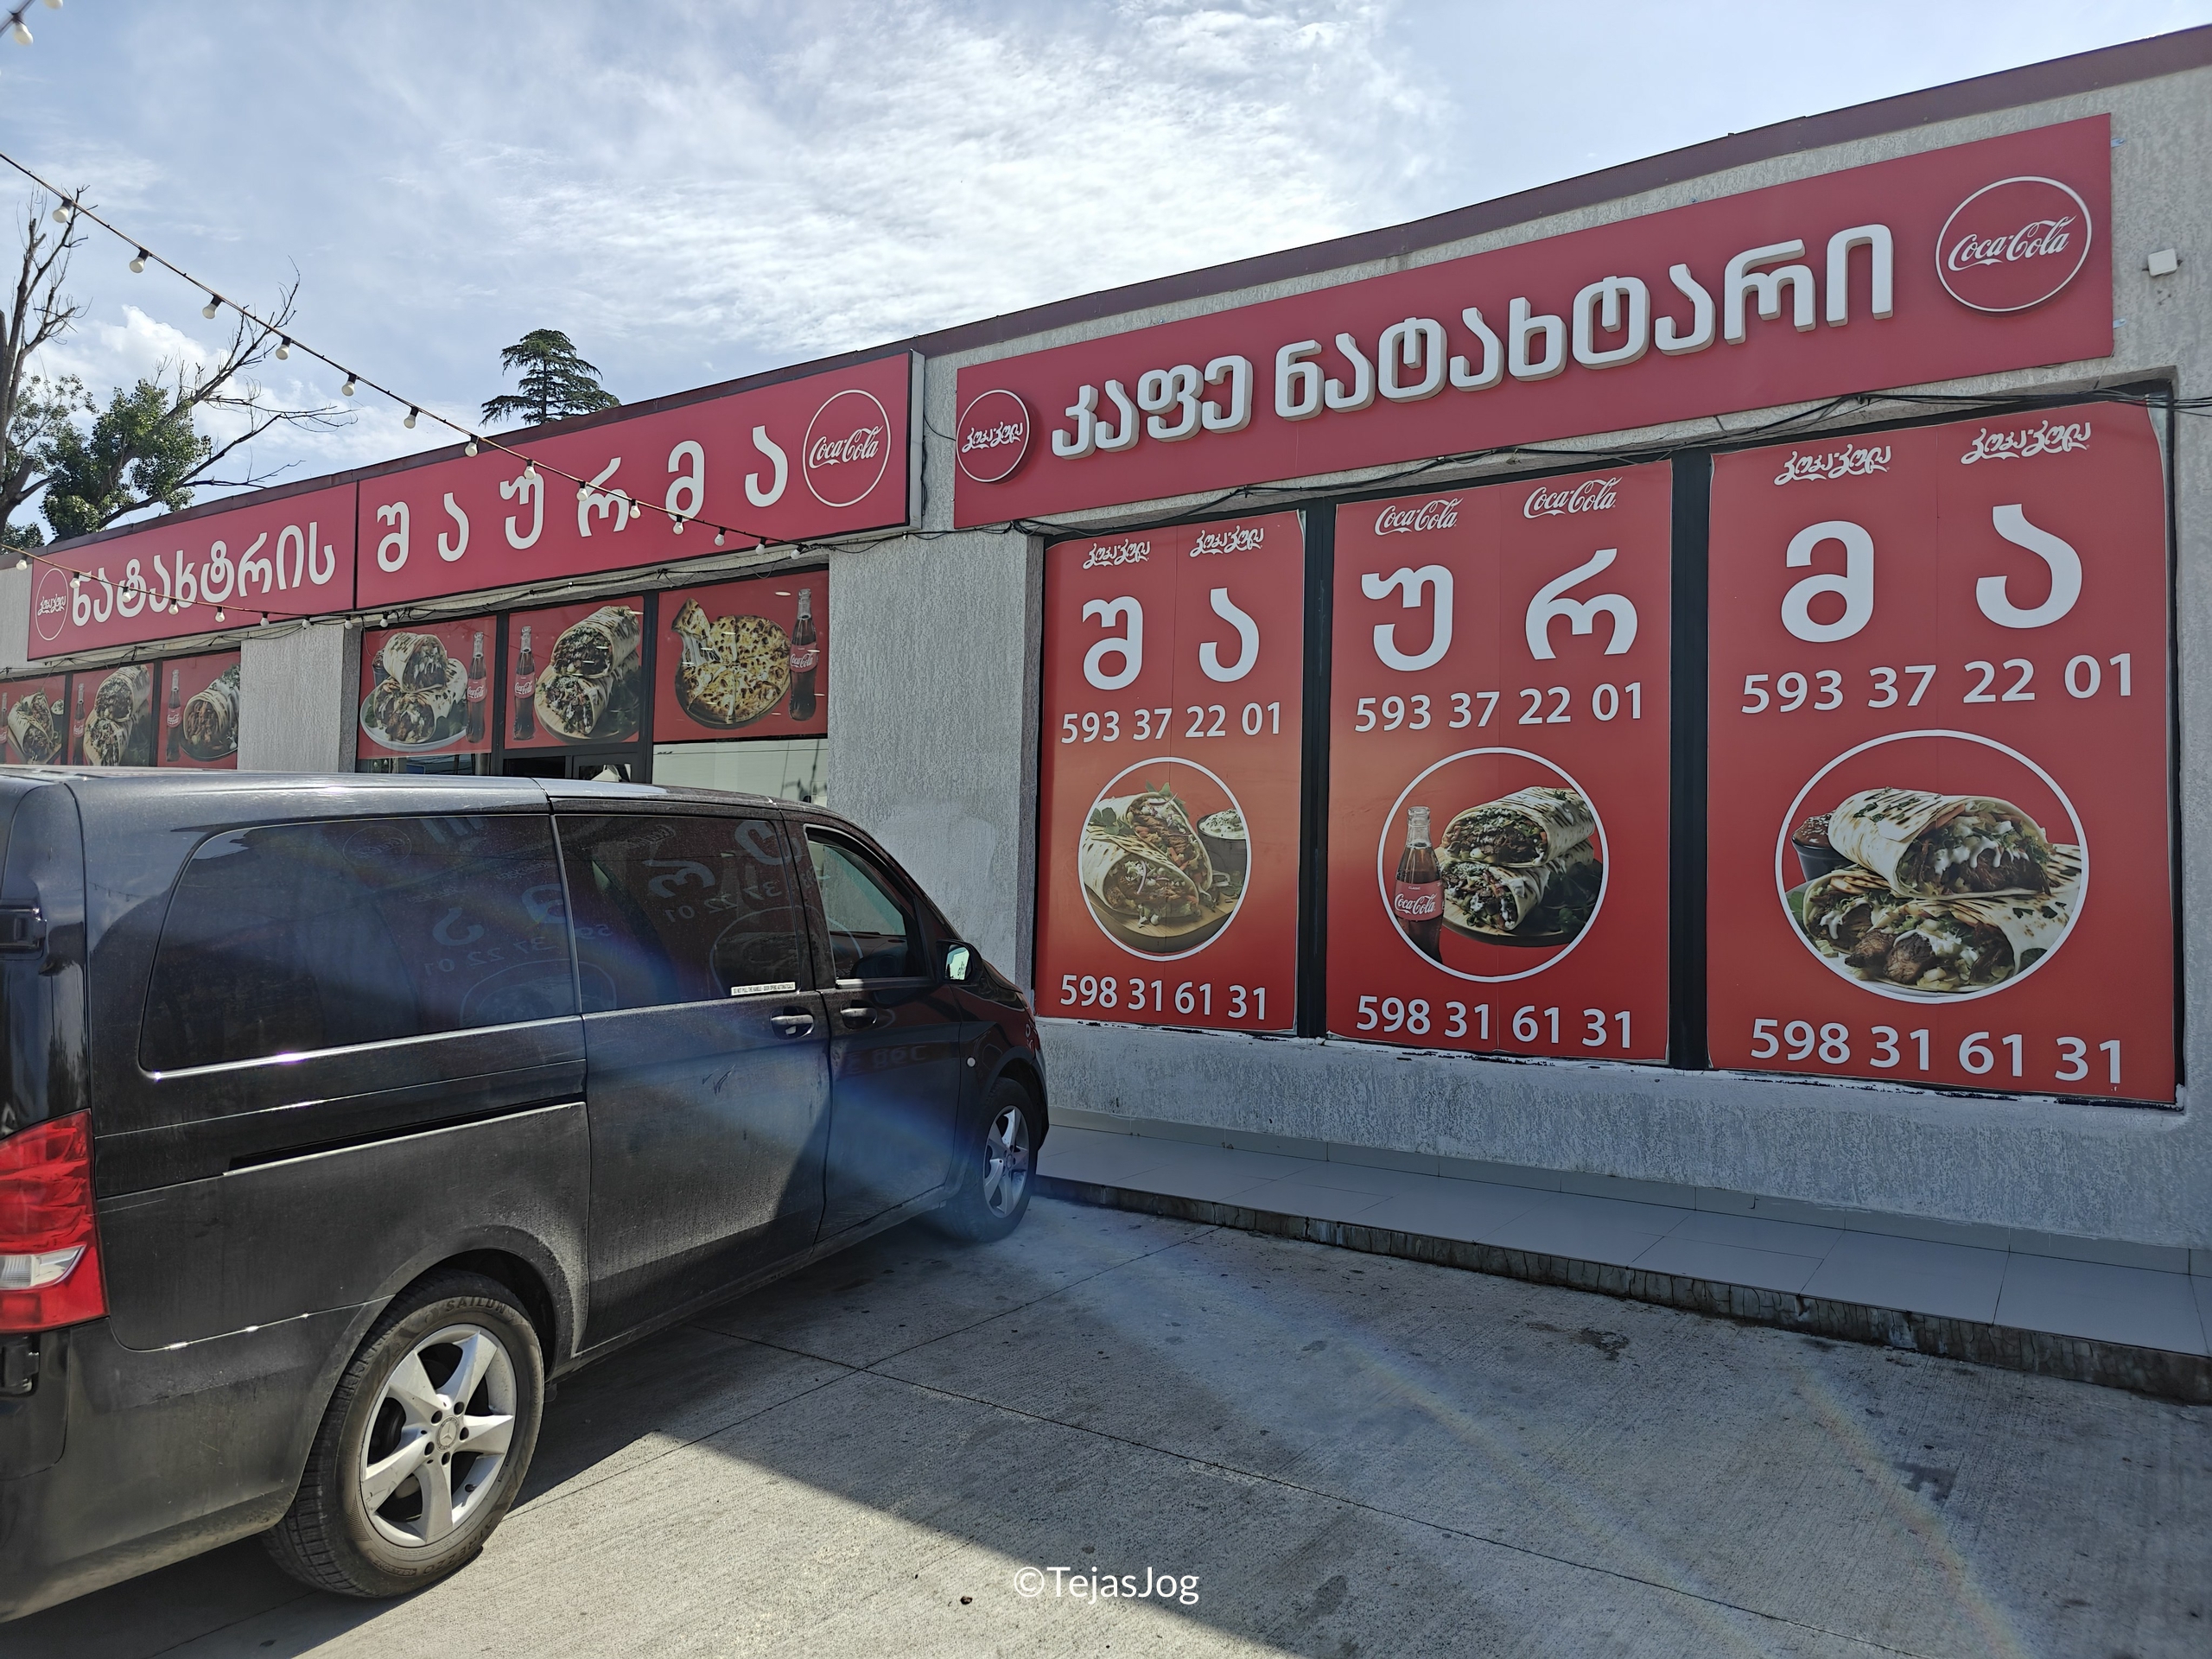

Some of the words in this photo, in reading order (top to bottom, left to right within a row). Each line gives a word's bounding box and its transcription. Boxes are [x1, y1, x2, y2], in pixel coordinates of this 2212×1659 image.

[1948, 215, 2077, 271] Coca-Cola
[1052, 354, 1255, 460] კაფე
[1274, 223, 1893, 421] ნატახტარი
[809, 425, 884, 469] Coca-Cola
[1374, 497, 1464, 536] Coca-Cola
[1523, 476, 1624, 519] Coca-Cola
[72, 521, 335, 627] ნატახტრის
[1353, 694, 1433, 734] 593
[1447, 690, 1501, 729] 37
[1517, 685, 1572, 726] 22
[1591, 682, 1642, 722] 01
[1740, 669, 1845, 715] 593
[1866, 664, 1937, 709] 37
[1962, 658, 2037, 704] 22
[2063, 652, 2132, 700] 01
[1060, 710, 1121, 745] 593
[1131, 708, 1173, 741] 37
[1184, 704, 1227, 739] 22
[1241, 701, 1281, 735] 01
[1394, 893, 1437, 915] Coca-Cola
[1059, 973, 1118, 1009] 598
[1127, 977, 1164, 1013] 31
[1173, 981, 1212, 1016] 61
[1227, 983, 1267, 1021] 31
[1356, 995, 1432, 1036] 598
[1443, 1001, 1490, 1040] 31
[1511, 1004, 1560, 1045] 61
[1581, 1007, 1631, 1049] 31
[1750, 1017, 1852, 1065] 598
[1868, 1025, 1930, 1071] 31
[1958, 1030, 2024, 1078] 61
[2054, 1035, 2121, 1084] 31
